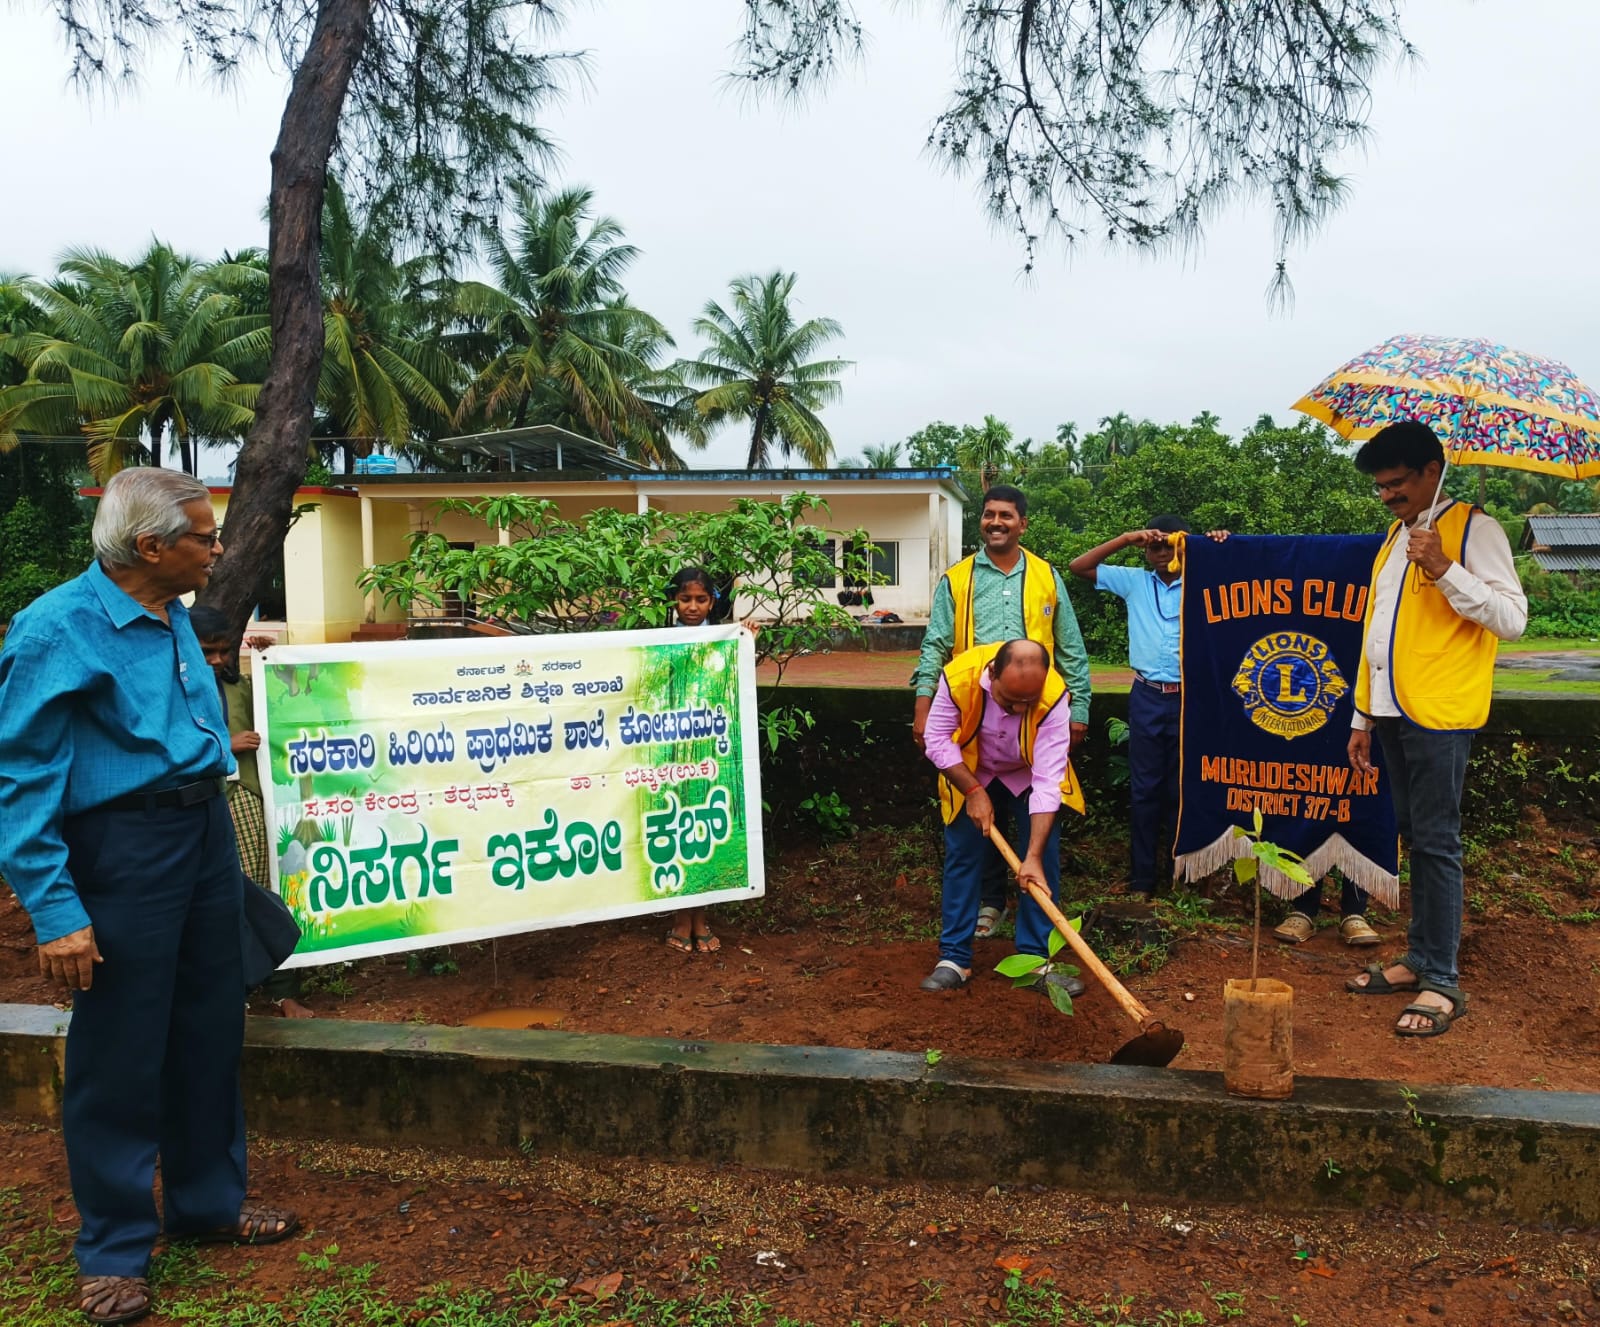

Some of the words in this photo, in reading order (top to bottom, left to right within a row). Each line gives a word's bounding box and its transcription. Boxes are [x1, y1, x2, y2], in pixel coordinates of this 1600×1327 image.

[1202, 578, 1293, 624] LIONS
[1302, 578, 1368, 623] CLU
[1254, 633, 1324, 658] LIONS
[456, 664, 506, 677] ಕರ್ನಾಟಕ
[541, 659, 582, 672] ಸರಕಾರ
[1275, 663, 1307, 702] L
[412, 683, 511, 706] ಸಾರ್ವಜನಿಕ
[520, 681, 564, 704] ಶಿಕ್ಷಣ
[572, 675, 624, 697] ಇಲಾಖೆ
[288, 728, 376, 775] ಸರಕಾರಿ
[388, 720, 455, 766] ಹಿರಿಯ
[465, 712, 553, 774] ಪ್ರಾಥಮಿಕ
[563, 708, 610, 751] ಶಾಲೆ,
[618, 700, 730, 754] ಕೋಟದಮಕ್ಕಿ
[1257, 711, 1322, 732] INTERNATIONAL
[1201, 754, 1380, 796] MURUDESHWAR
[365, 789, 421, 815] ಕೇಂದ್ರ
[1226, 787, 1301, 817] DISTRICT
[1303, 795, 1351, 823] 317-B
[308, 822, 459, 913] ನಿಸರ್ಗ
[486, 807, 622, 891] ಇಕೋ
[645, 788, 729, 889] ಕ್ಲಬ್
